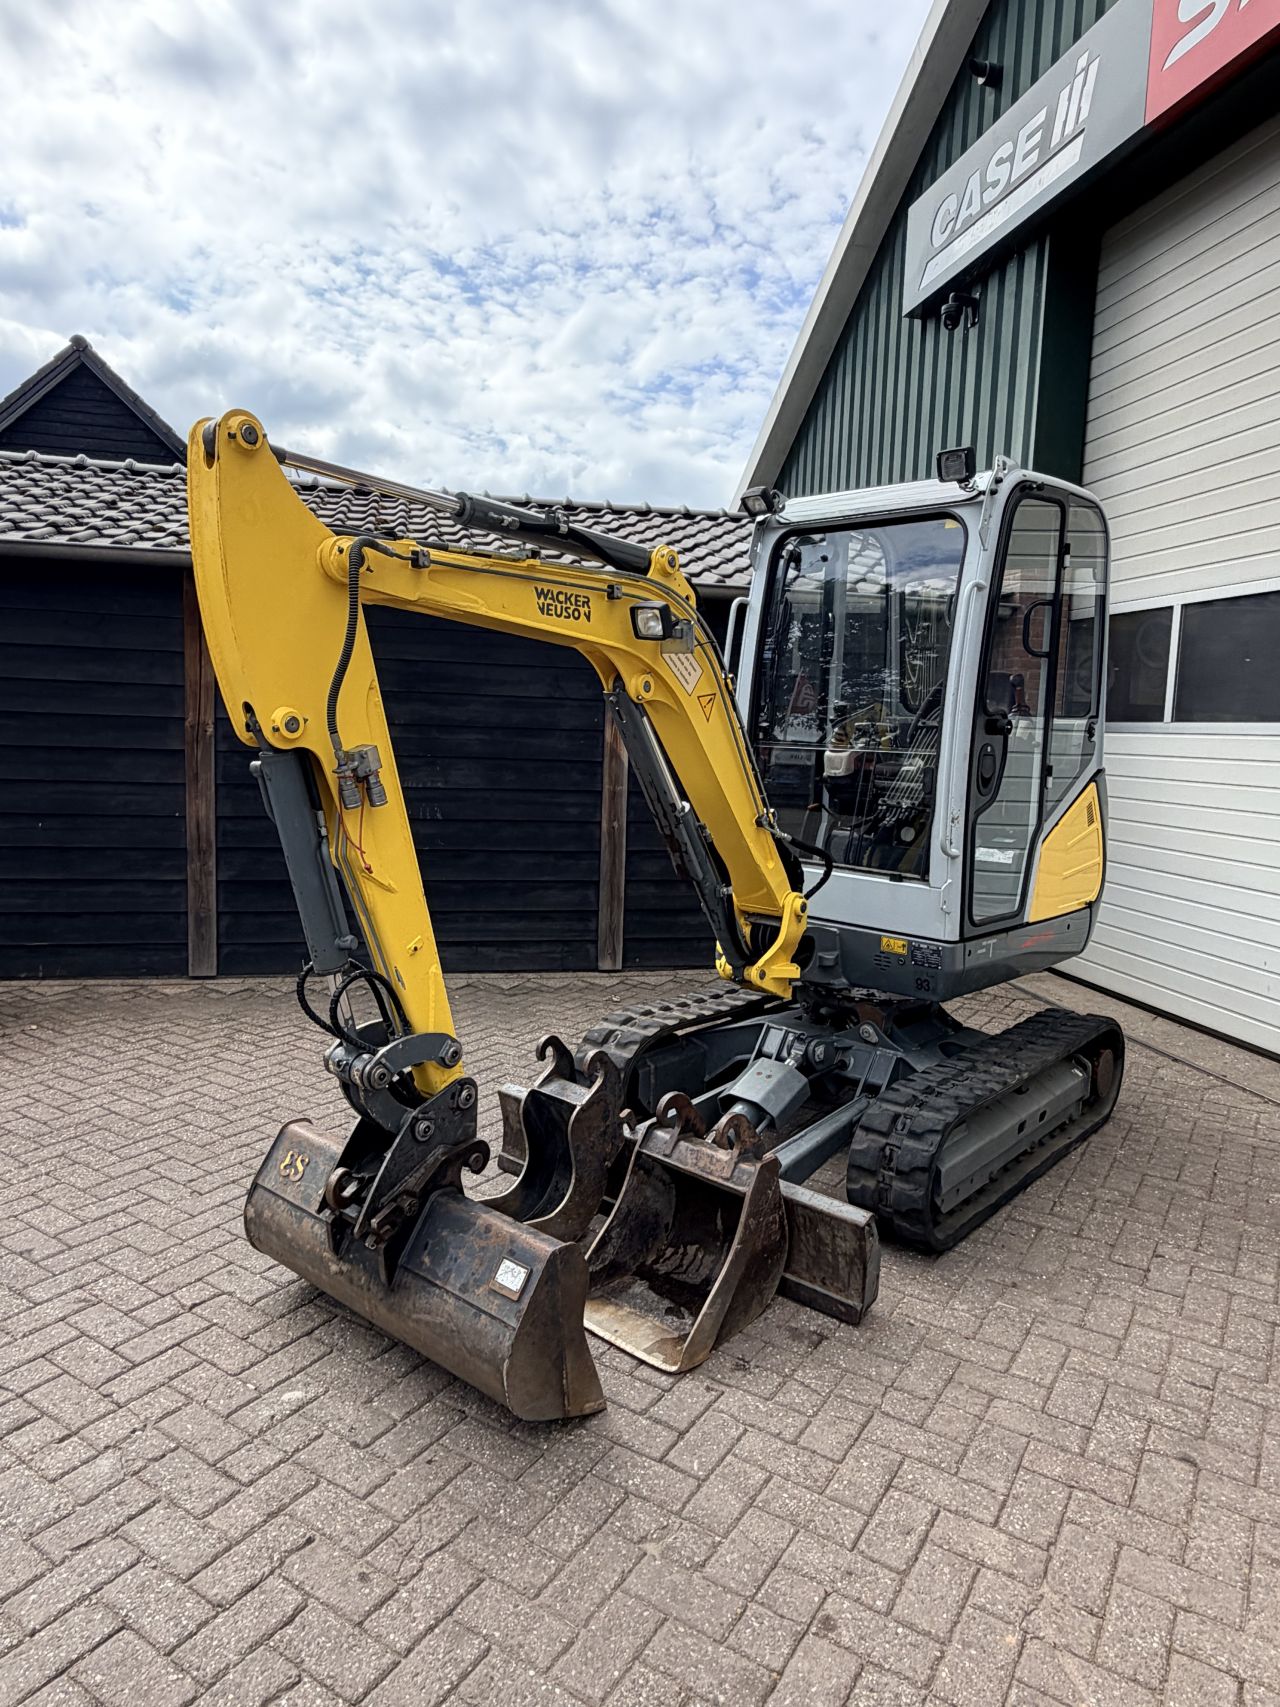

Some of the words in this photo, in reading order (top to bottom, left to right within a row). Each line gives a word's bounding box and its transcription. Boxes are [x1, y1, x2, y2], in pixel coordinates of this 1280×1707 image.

[931, 105, 1048, 248] CASE
[534, 586, 591, 609] WACKER
[537, 601, 591, 623] NEUSON
